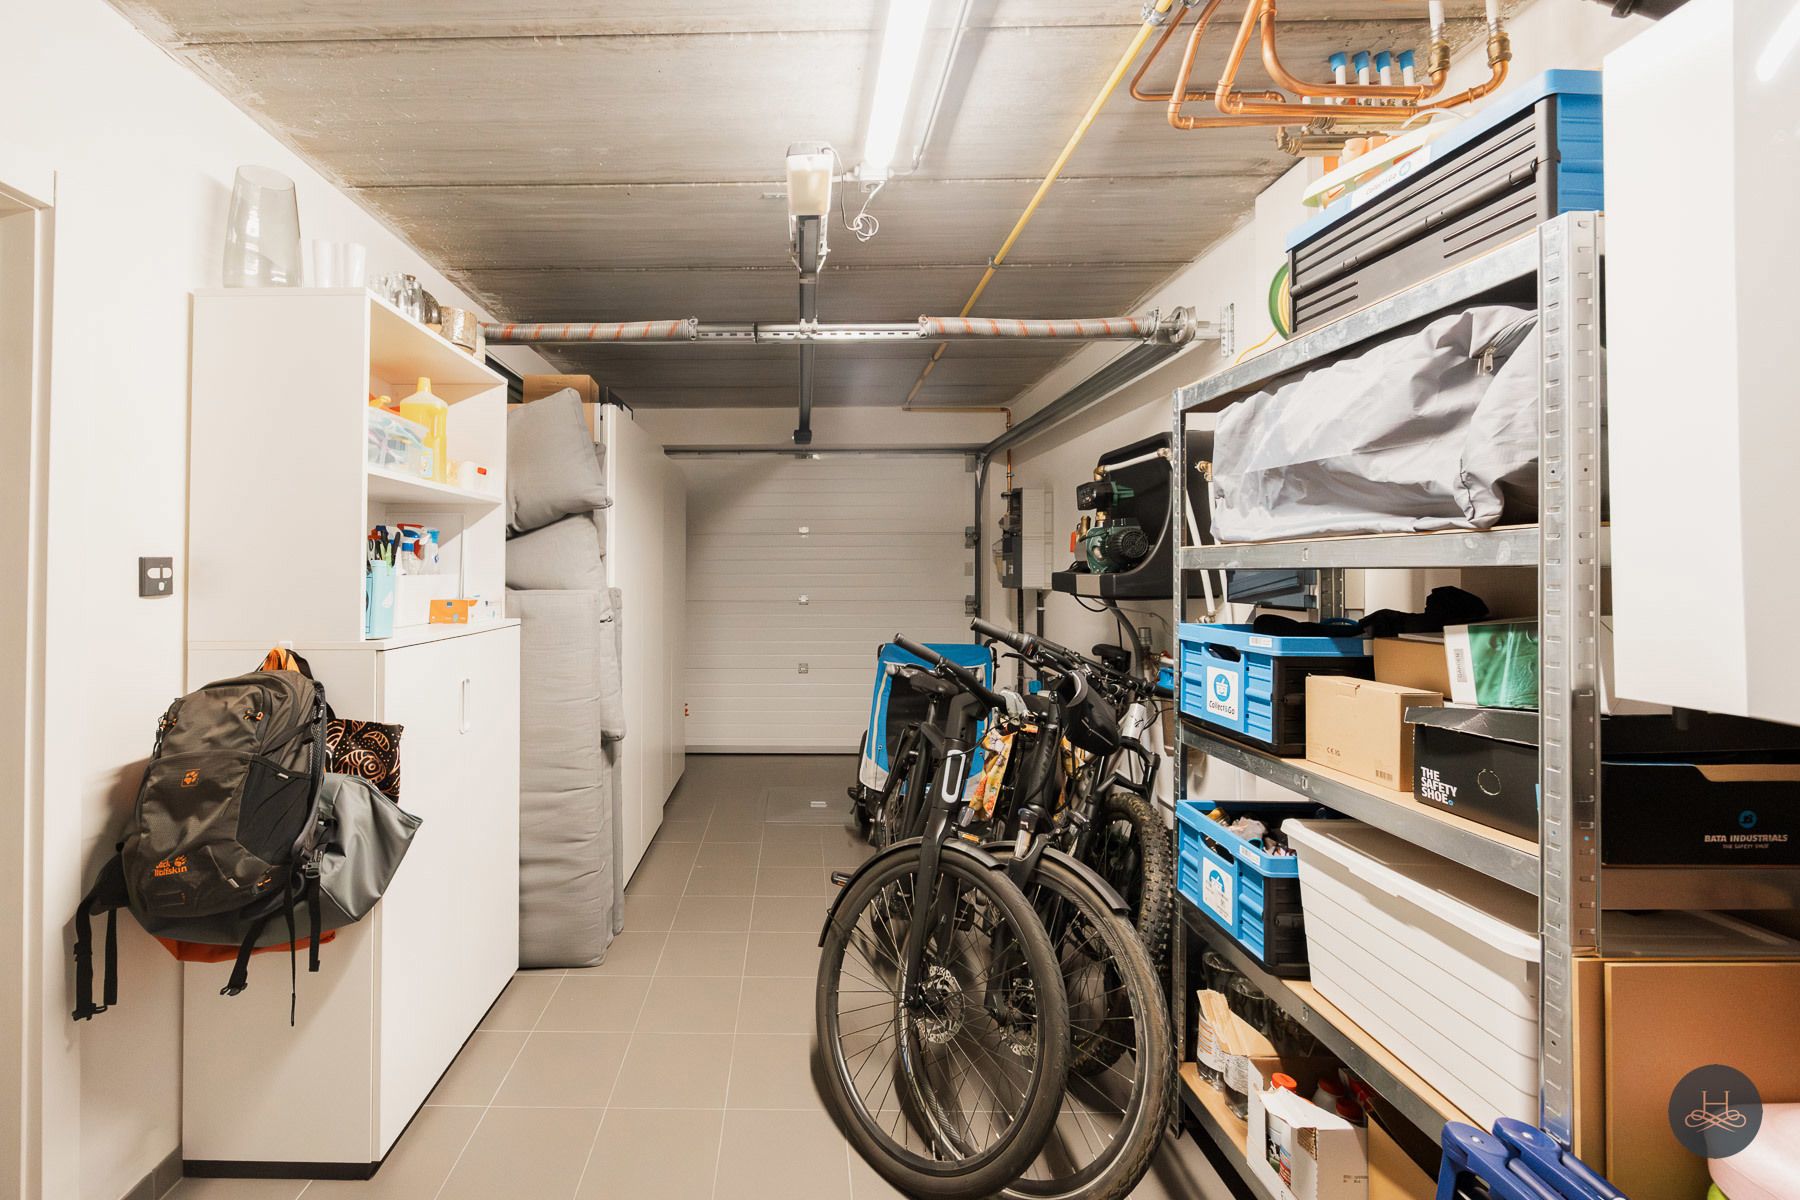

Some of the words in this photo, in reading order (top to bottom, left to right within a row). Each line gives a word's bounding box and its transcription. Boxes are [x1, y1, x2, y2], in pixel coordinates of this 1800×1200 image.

[1420, 766, 1440, 781] THE
[1420, 777, 1458, 797] SAFETY
[1704, 834, 1727, 843] BATA
[1730, 834, 1788, 842] INDUSTRIALS
